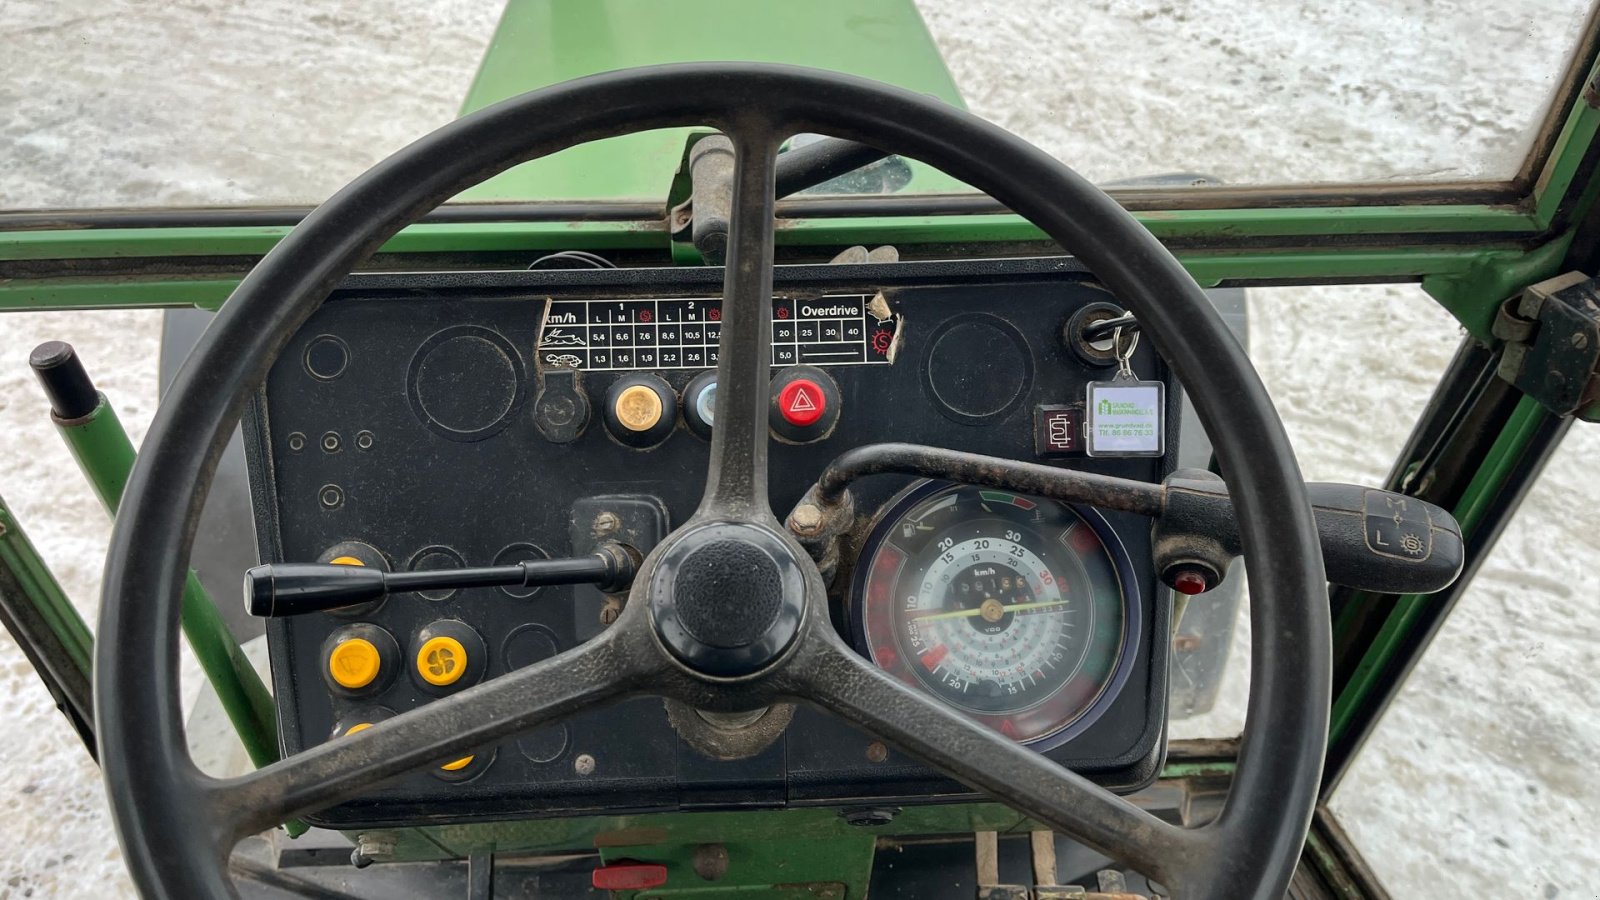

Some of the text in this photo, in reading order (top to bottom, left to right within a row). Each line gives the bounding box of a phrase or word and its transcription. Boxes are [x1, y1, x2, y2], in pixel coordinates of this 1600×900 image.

[802, 305, 859, 316] Overdrive
[662, 332, 675, 340] 8,6
[938, 530, 1022, 552] 20 30
[1376, 530, 1390, 546] L
[942, 540, 1025, 565] 15 20 25
[1007, 558, 1018, 567] 20
[974, 568, 996, 577] km/h
[1040, 570, 1053, 585] 30
[907, 596, 917, 609] 10
[950, 680, 1017, 695] 20 15
